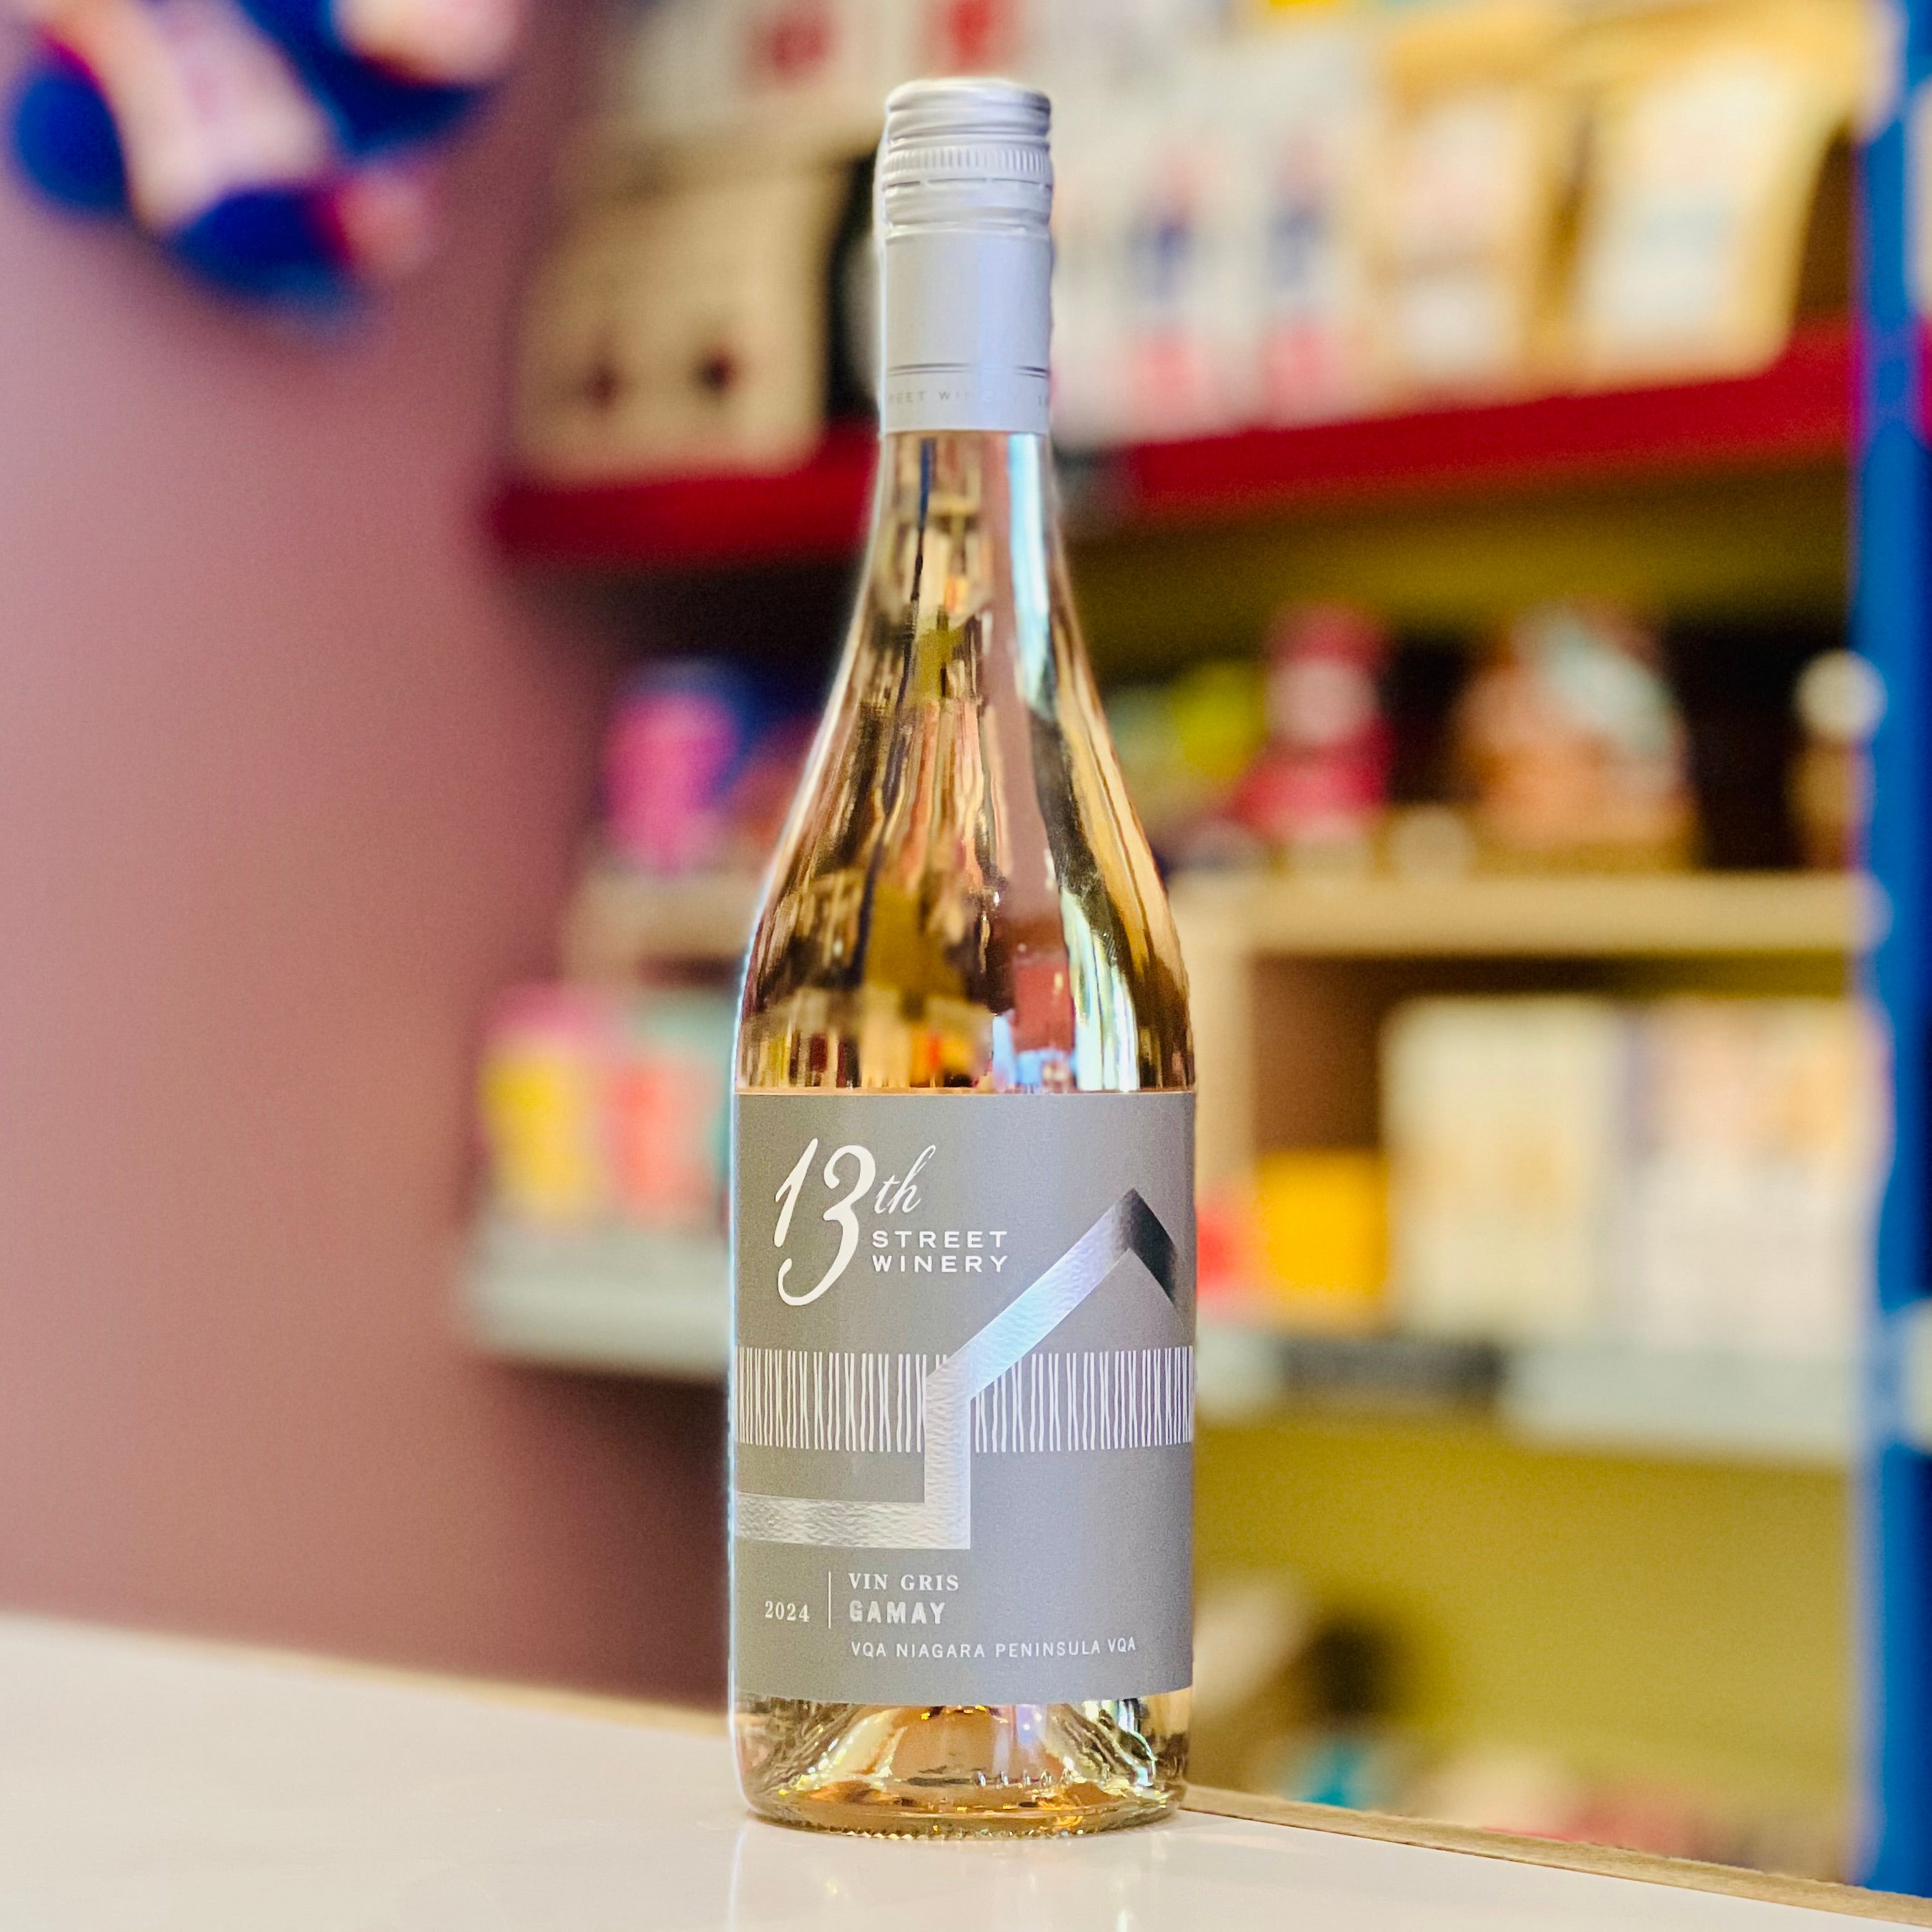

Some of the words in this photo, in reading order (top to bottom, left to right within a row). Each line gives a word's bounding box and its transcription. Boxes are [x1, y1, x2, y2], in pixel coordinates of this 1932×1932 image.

[774, 1138, 936, 1306] 13th
[872, 1230, 1007, 1249] STREET
[872, 1255, 1008, 1273] WINERY
[848, 1572, 888, 1590] VIN
[901, 1574, 959, 1592] GRIS
[765, 1600, 810, 1623] 2024
[849, 1600, 946, 1625] GAMAY
[851, 1641, 886, 1658] VQA
[896, 1643, 986, 1658] NIAGARA
[996, 1639, 1101, 1658] PENINSULA
[1107, 1637, 1136, 1653] VQA
